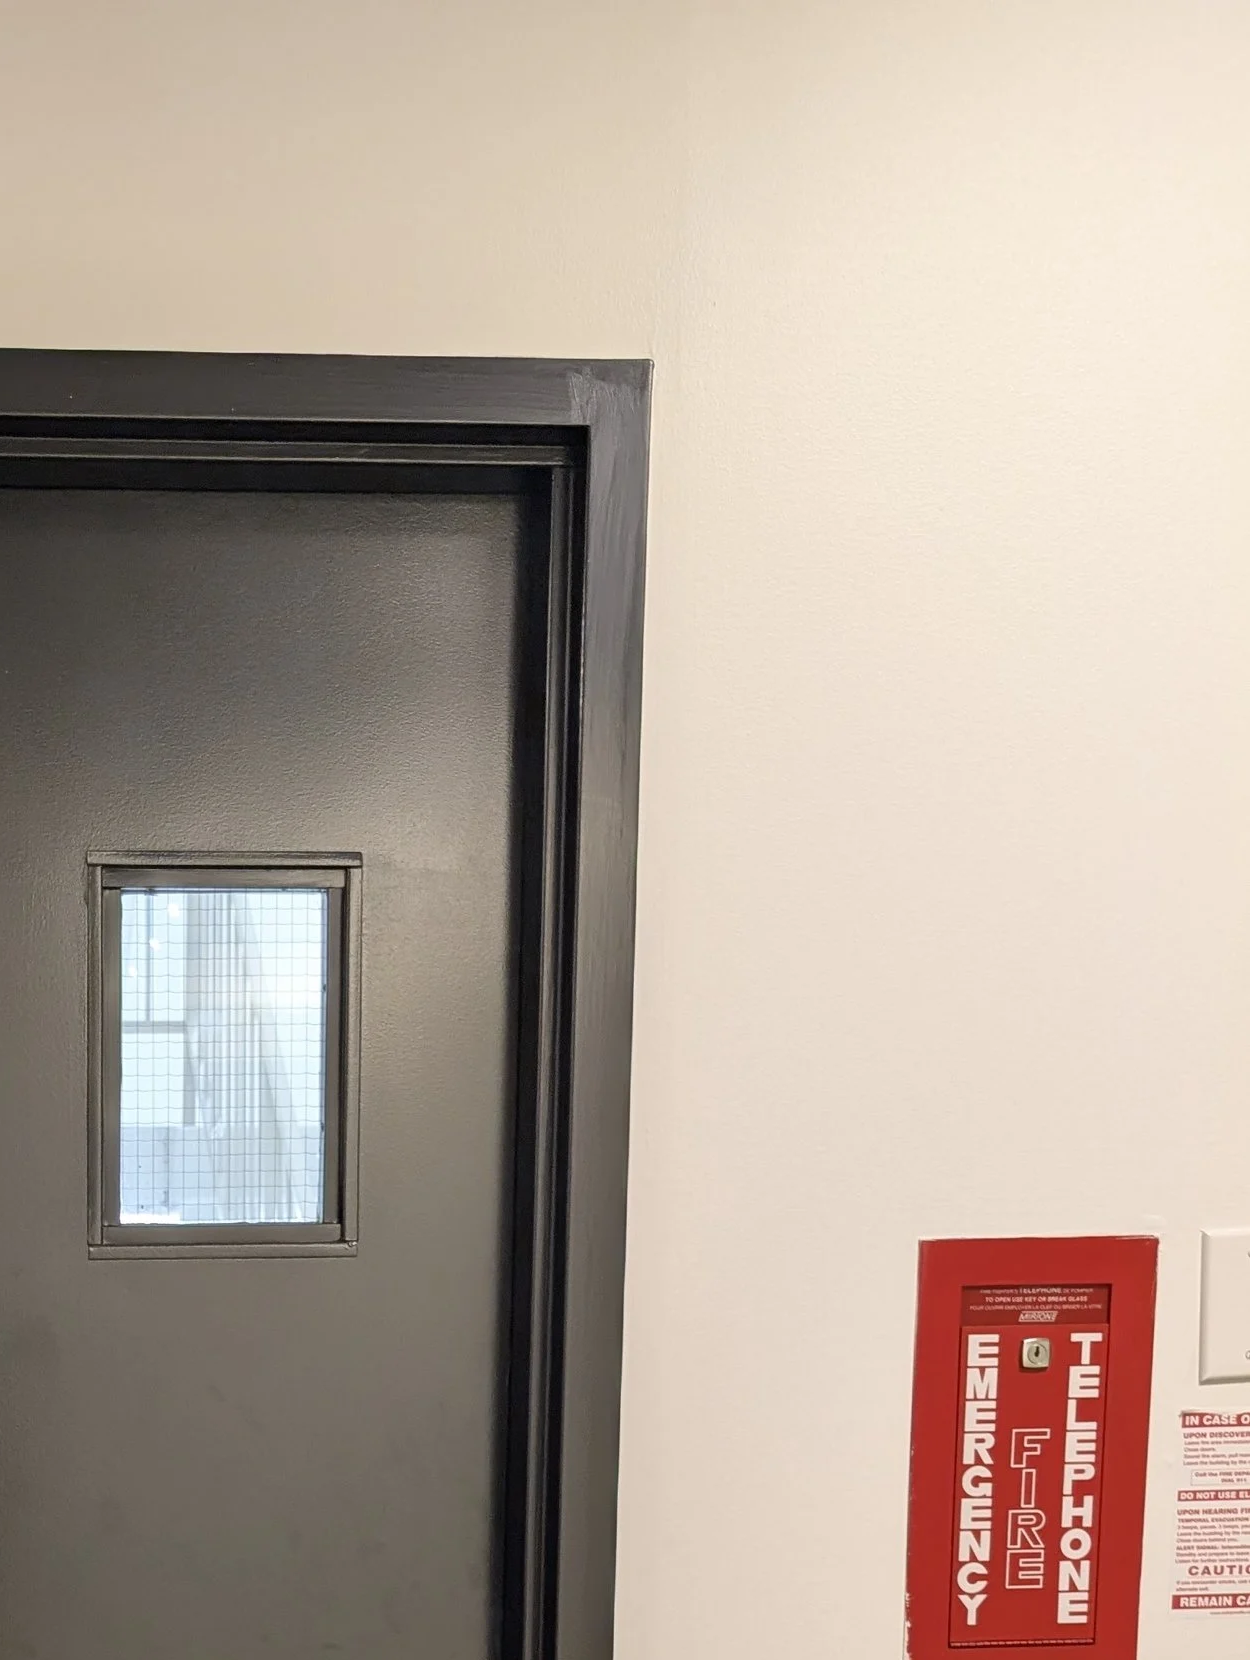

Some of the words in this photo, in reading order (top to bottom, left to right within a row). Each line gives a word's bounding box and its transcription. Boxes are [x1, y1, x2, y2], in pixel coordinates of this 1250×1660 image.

[956, 1333, 1000, 1626] EMERGENCY
[1057, 1332, 1103, 1625] TELEPHONE
[1185, 1416, 1200, 1425] IN
[1203, 1415, 1237, 1425] CASE
[1005, 1428, 1051, 1590] FIRE
[1180, 1596, 1232, 1607] REMAIN
